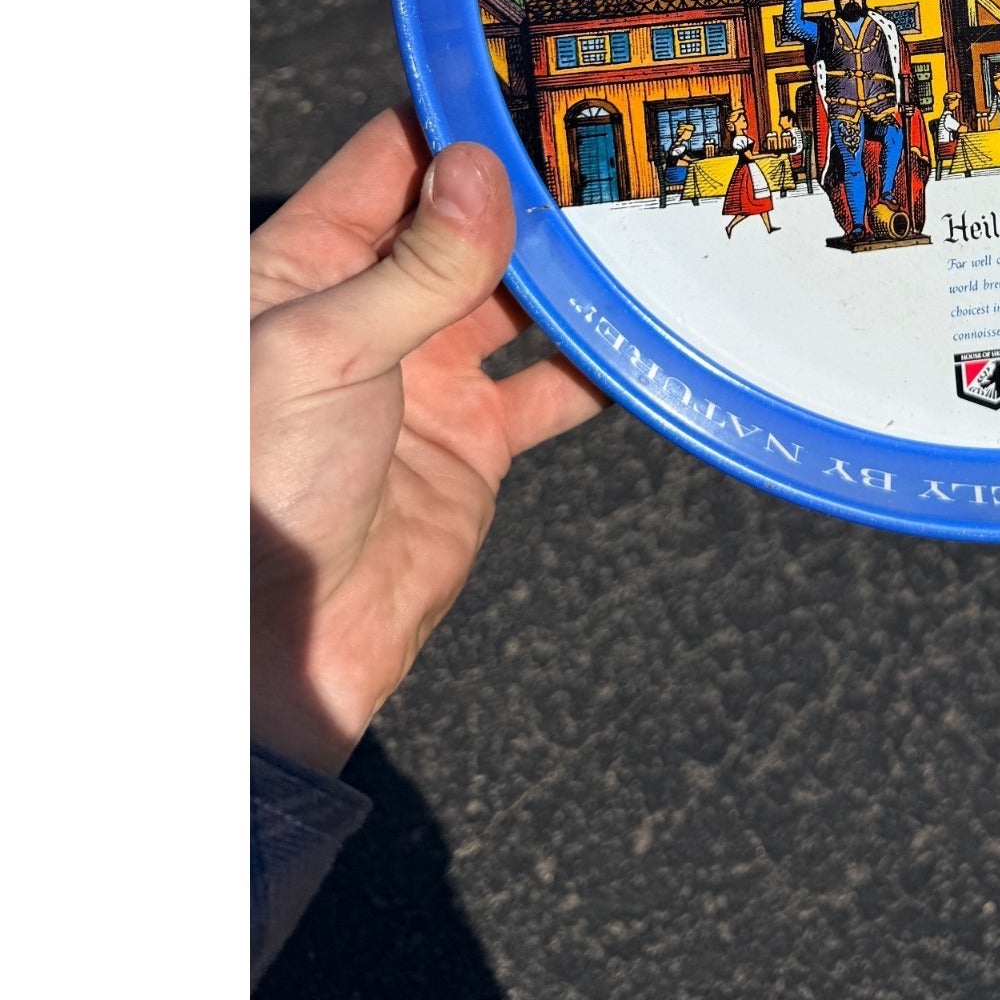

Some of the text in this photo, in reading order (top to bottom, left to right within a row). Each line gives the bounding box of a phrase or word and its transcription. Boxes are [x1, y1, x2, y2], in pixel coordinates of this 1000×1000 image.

[947, 258, 967, 271] For
[971, 255, 992, 268] well
[949, 280, 978, 294] world
[950, 304, 989, 318] choicest
[961, 352, 980, 360] HOUSE
[982, 350, 990, 358] OF
[823, 456, 897, 493] BY
